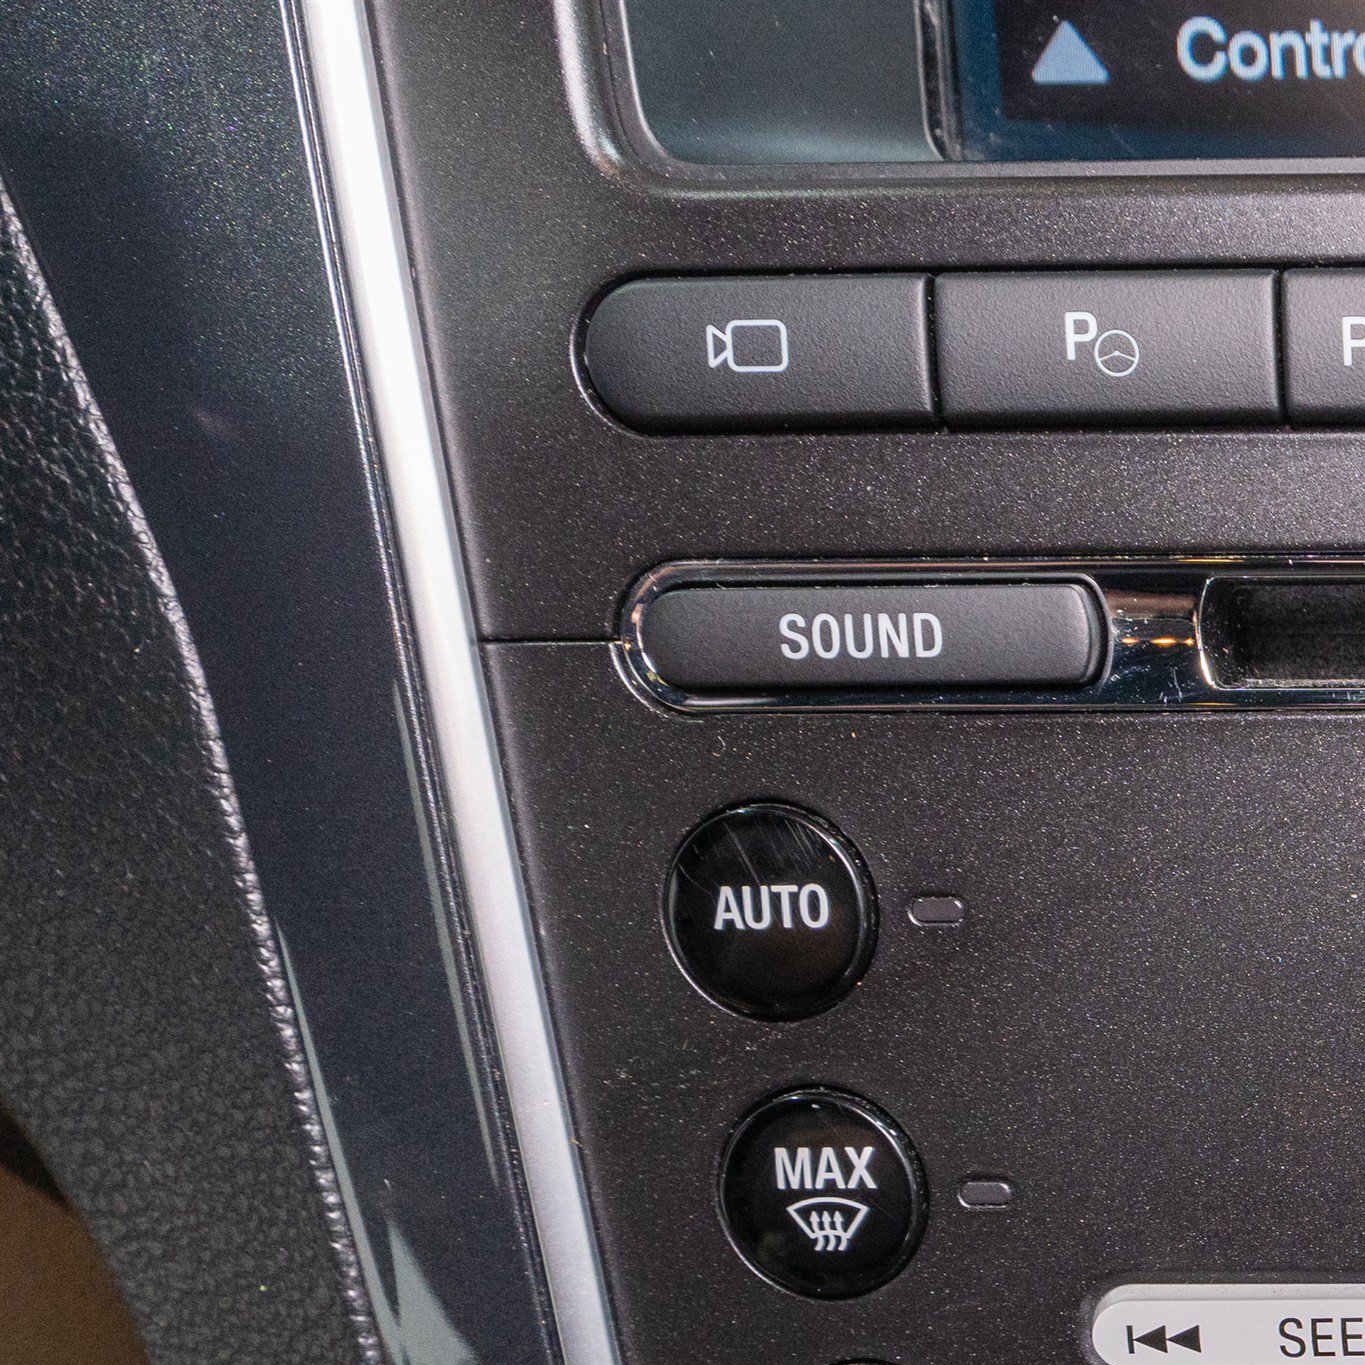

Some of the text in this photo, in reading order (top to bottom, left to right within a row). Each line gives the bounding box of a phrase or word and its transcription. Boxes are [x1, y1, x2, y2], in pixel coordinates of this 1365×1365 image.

[1064, 312, 1098, 360] P
[779, 612, 943, 659] SOUND
[714, 883, 829, 930] AUTO
[773, 1146, 878, 1190] MAX
